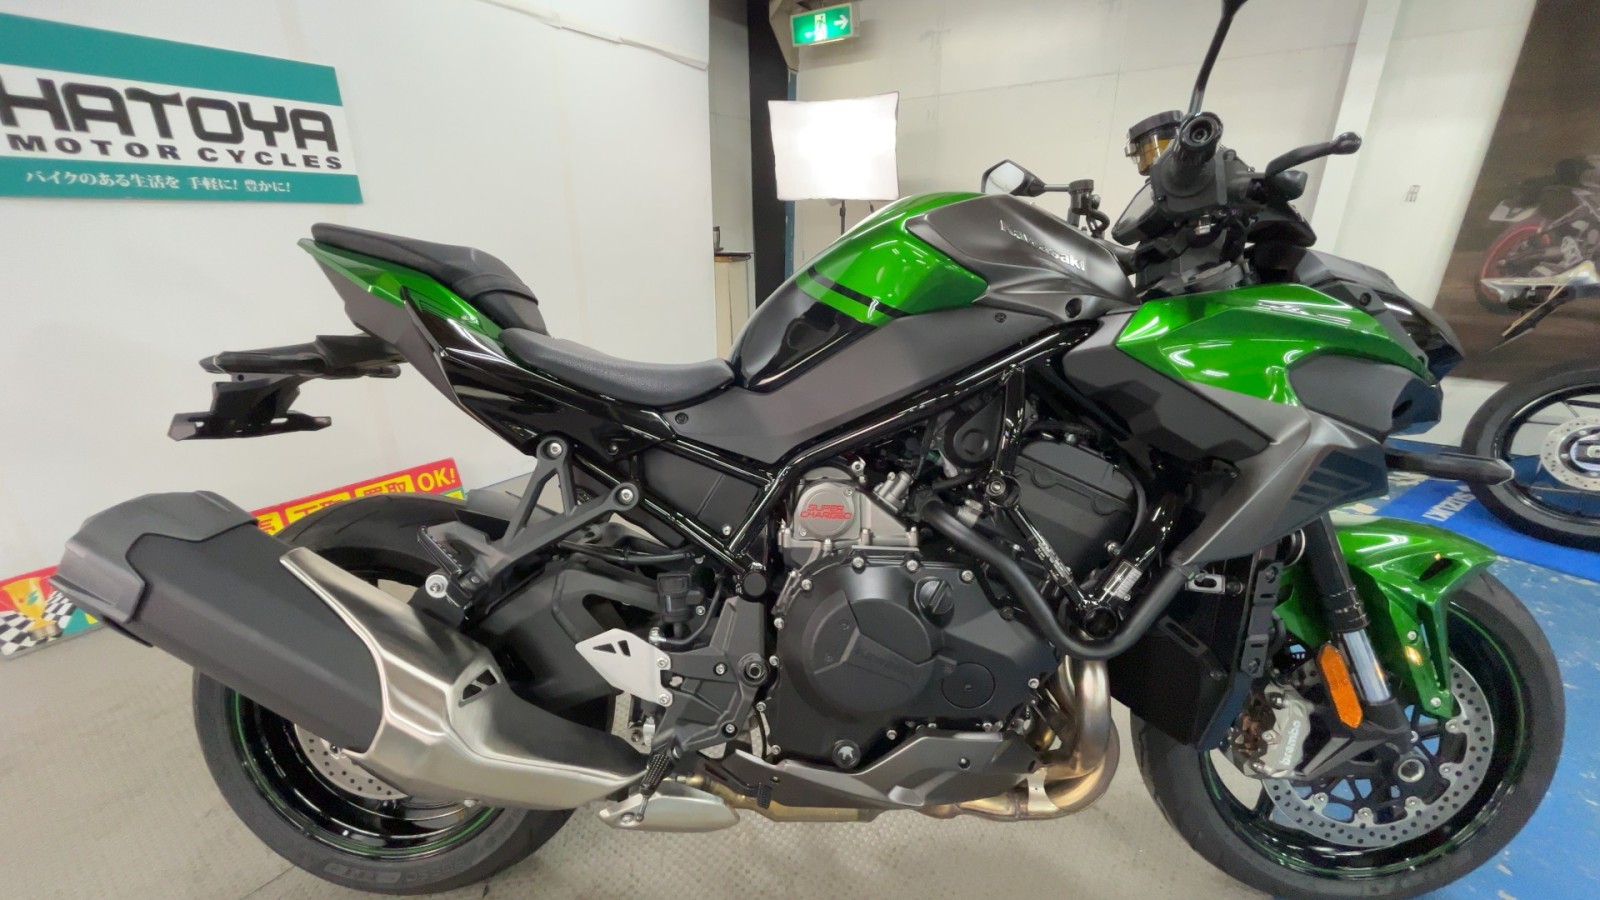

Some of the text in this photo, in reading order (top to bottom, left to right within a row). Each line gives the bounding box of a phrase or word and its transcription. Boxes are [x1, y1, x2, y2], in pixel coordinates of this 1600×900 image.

[0, 74, 339, 152] HATOYA
[6, 134, 343, 169] MOTOR CYCLES
[26, 170, 180, 190] バイクのある生活を
[417, 467, 456, 492] OK!
[807, 504, 845, 512] SUPER
[1279, 720, 1301, 766] brembo
